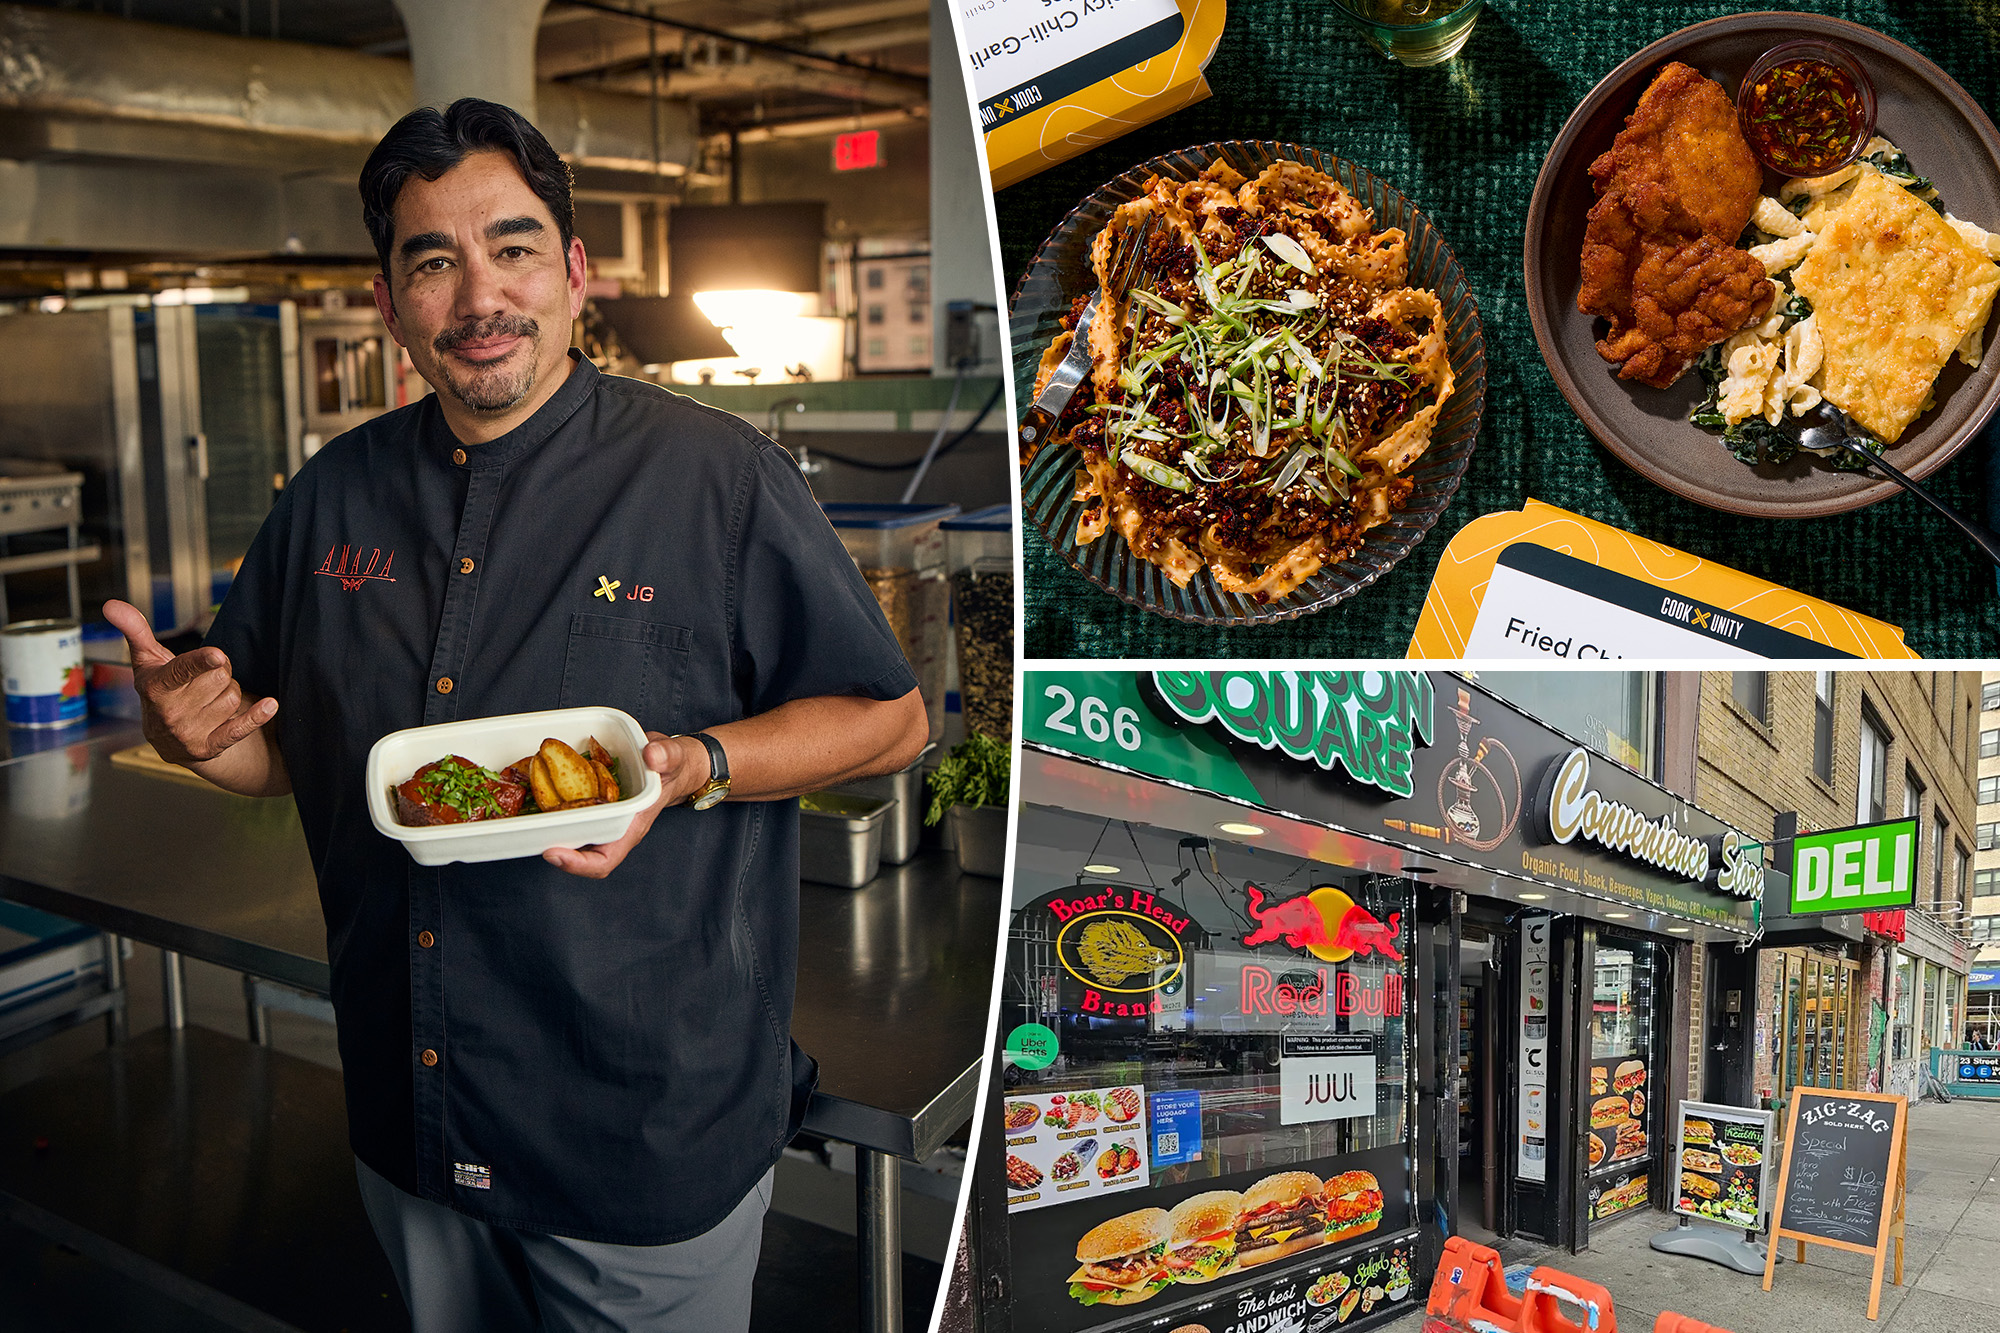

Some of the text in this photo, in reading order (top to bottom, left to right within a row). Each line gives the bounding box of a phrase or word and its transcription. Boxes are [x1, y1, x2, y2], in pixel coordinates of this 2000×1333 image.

[965, 0, 995, 18] Chili
[1010, 85, 1043, 111] COOK
[319, 544, 396, 577] AMADA
[626, 584, 655, 602] JG
[1660, 597, 1744, 640] COOK UNITY
[1504, 617, 1573, 659] Fried
[1043, 684, 1142, 752] 266
[1549, 746, 1764, 900] Convenience Store
[1522, 851, 1557, 878] Organic
[1559, 865, 1582, 887] Food,
[1583, 871, 1608, 893] Snack,
[1609, 877, 1645, 903] Beverages,
[1645, 888, 1665, 907] Vapes,
[1796, 833, 1911, 902] DELI
[1047, 887, 1190, 935] Boar's Head
[1080, 989, 1166, 1017] Brand
[1241, 965, 1402, 1017] Red Bull
[1021, 1038, 1047, 1047] Uber
[1021, 1047, 1048, 1057] Eats
[1963, 1067, 1971, 1075] C
[1980, 1067, 1988, 1076] E
[1973, 1057, 1999, 1065] Street
[1304, 1072, 1358, 1106] JUUL
[1156, 1110, 1187, 1118] LUGGAGE
[1801, 1101, 1890, 1134] ZIG-ZAG
[1798, 1131, 1847, 1151] Special
[1822, 1198, 1841, 1208] with
[1843, 1194, 1876, 1211] Free
[1354, 1252, 1390, 1287] Salad
[1237, 1283, 1297, 1318] The best
